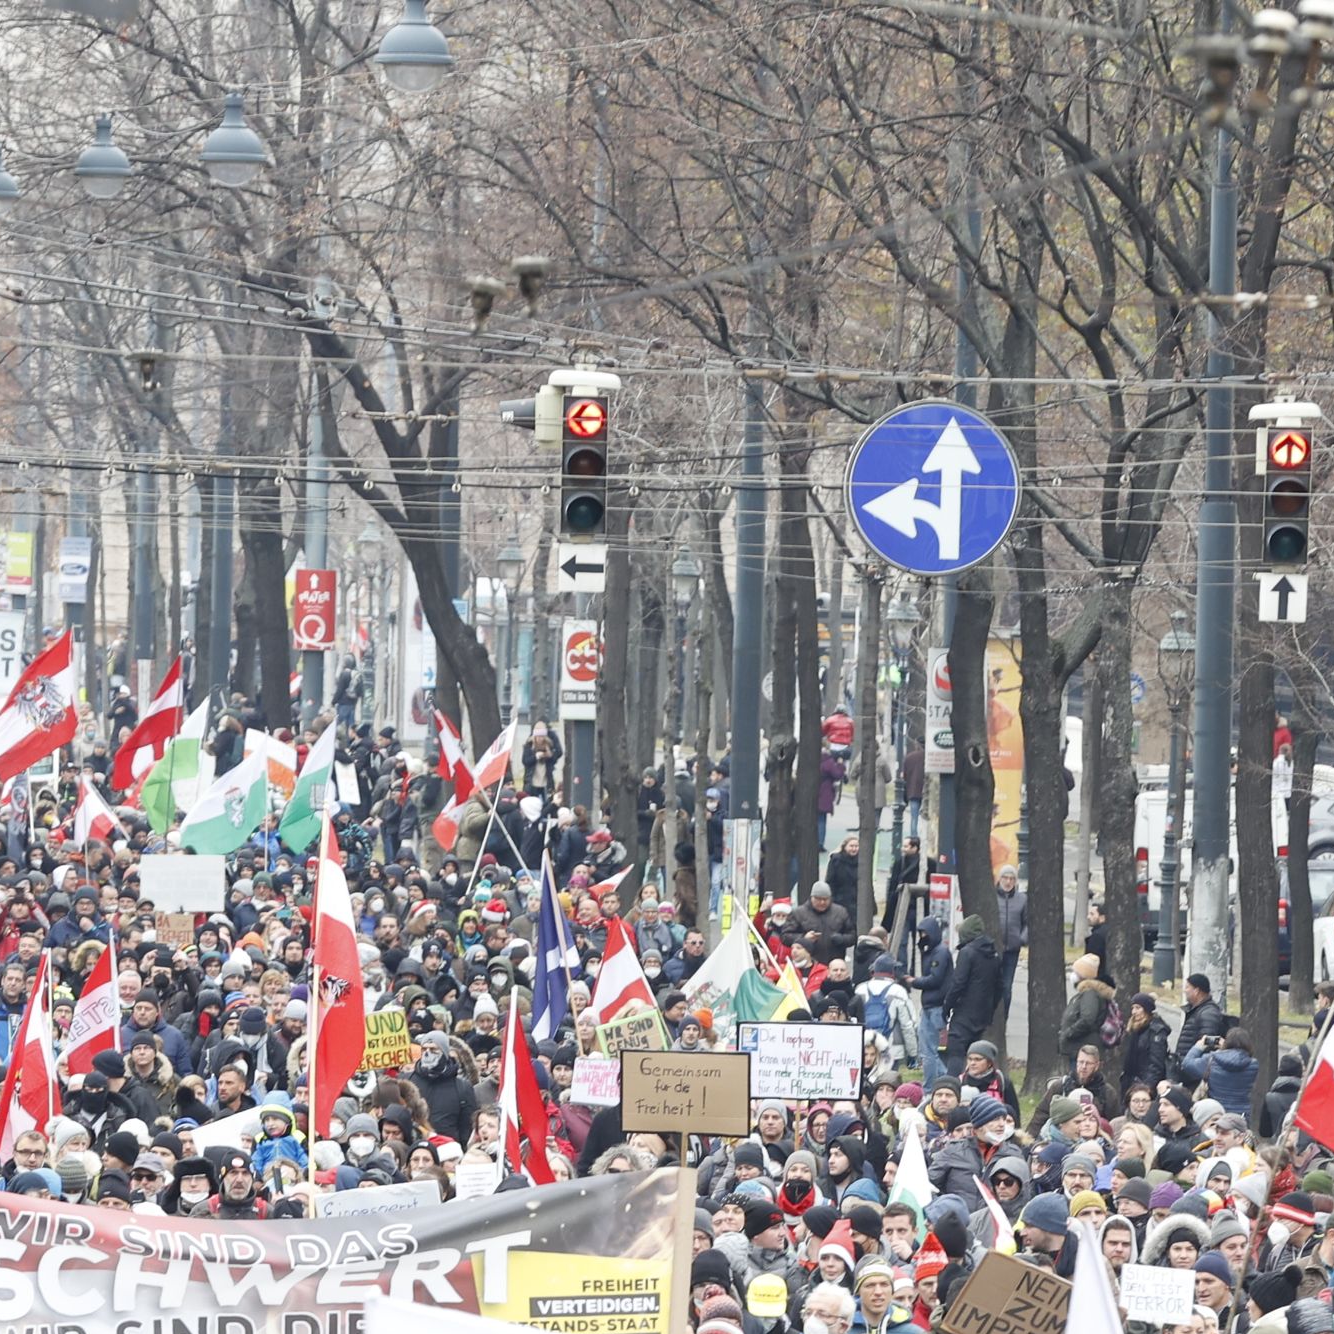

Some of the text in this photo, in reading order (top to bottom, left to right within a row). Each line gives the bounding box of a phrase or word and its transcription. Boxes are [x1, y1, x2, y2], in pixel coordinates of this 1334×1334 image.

[365, 1011, 405, 1036] UND
[627, 1018, 654, 1037] SIND
[382, 1034, 407, 1049] KEIN
[358, 1047, 414, 1071] BRECHEN
[640, 1057, 722, 1078] Gemeinsam
[798, 1051, 832, 1068] NICHT
[635, 1099, 694, 1117] Freiheit
[119, 1225, 267, 1268] SIND
[284, 1222, 421, 1269] DAS
[582, 1278, 660, 1293] FREIHEIT
[1125, 1281, 1183, 1297] DEN TEST
[537, 1297, 660, 1315] VERTEIDIGEN.
[1124, 1293, 1186, 1314] TERROR
